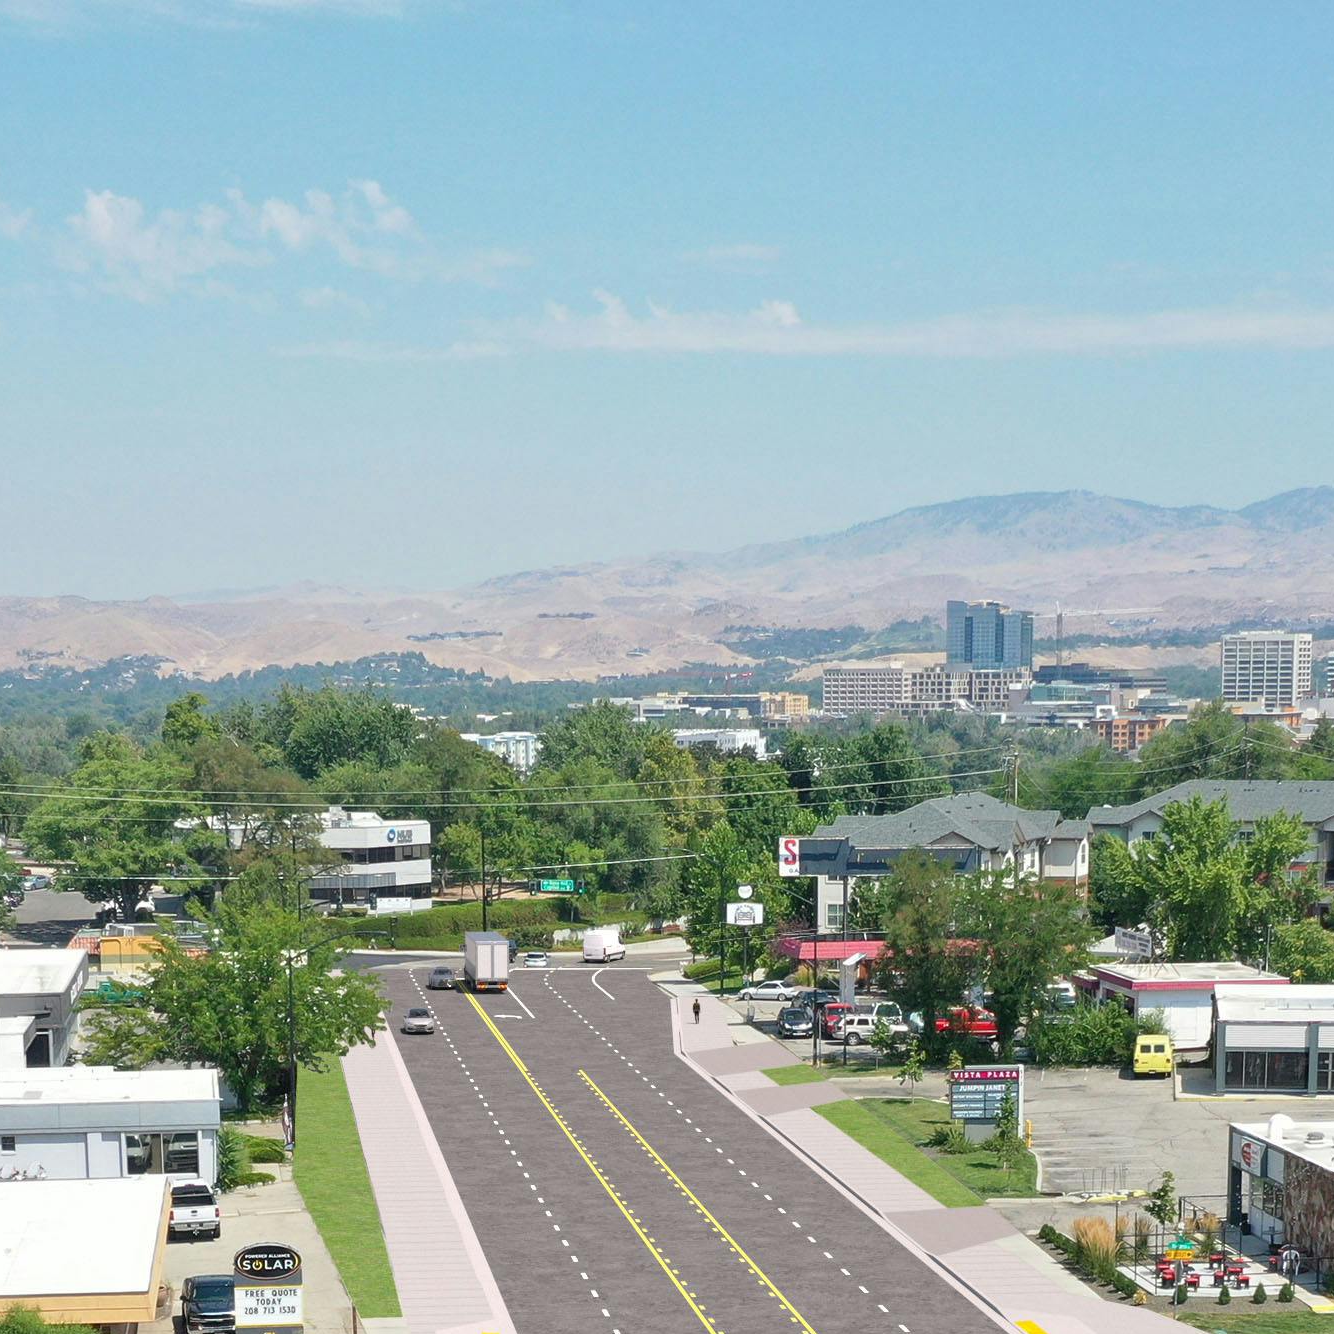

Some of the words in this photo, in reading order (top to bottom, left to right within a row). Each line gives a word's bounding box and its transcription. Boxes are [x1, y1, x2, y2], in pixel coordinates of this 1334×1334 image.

[953, 1071, 981, 1079] VISTA
[242, 1259, 294, 1271] SOLAR
[244, 1290, 265, 1298] FREE
[271, 1289, 298, 1297] QUOTE
[256, 1298, 282, 1306] TODAY
[244, 1307, 259, 1315] 208
[279, 1306, 296, 1314] 1530
